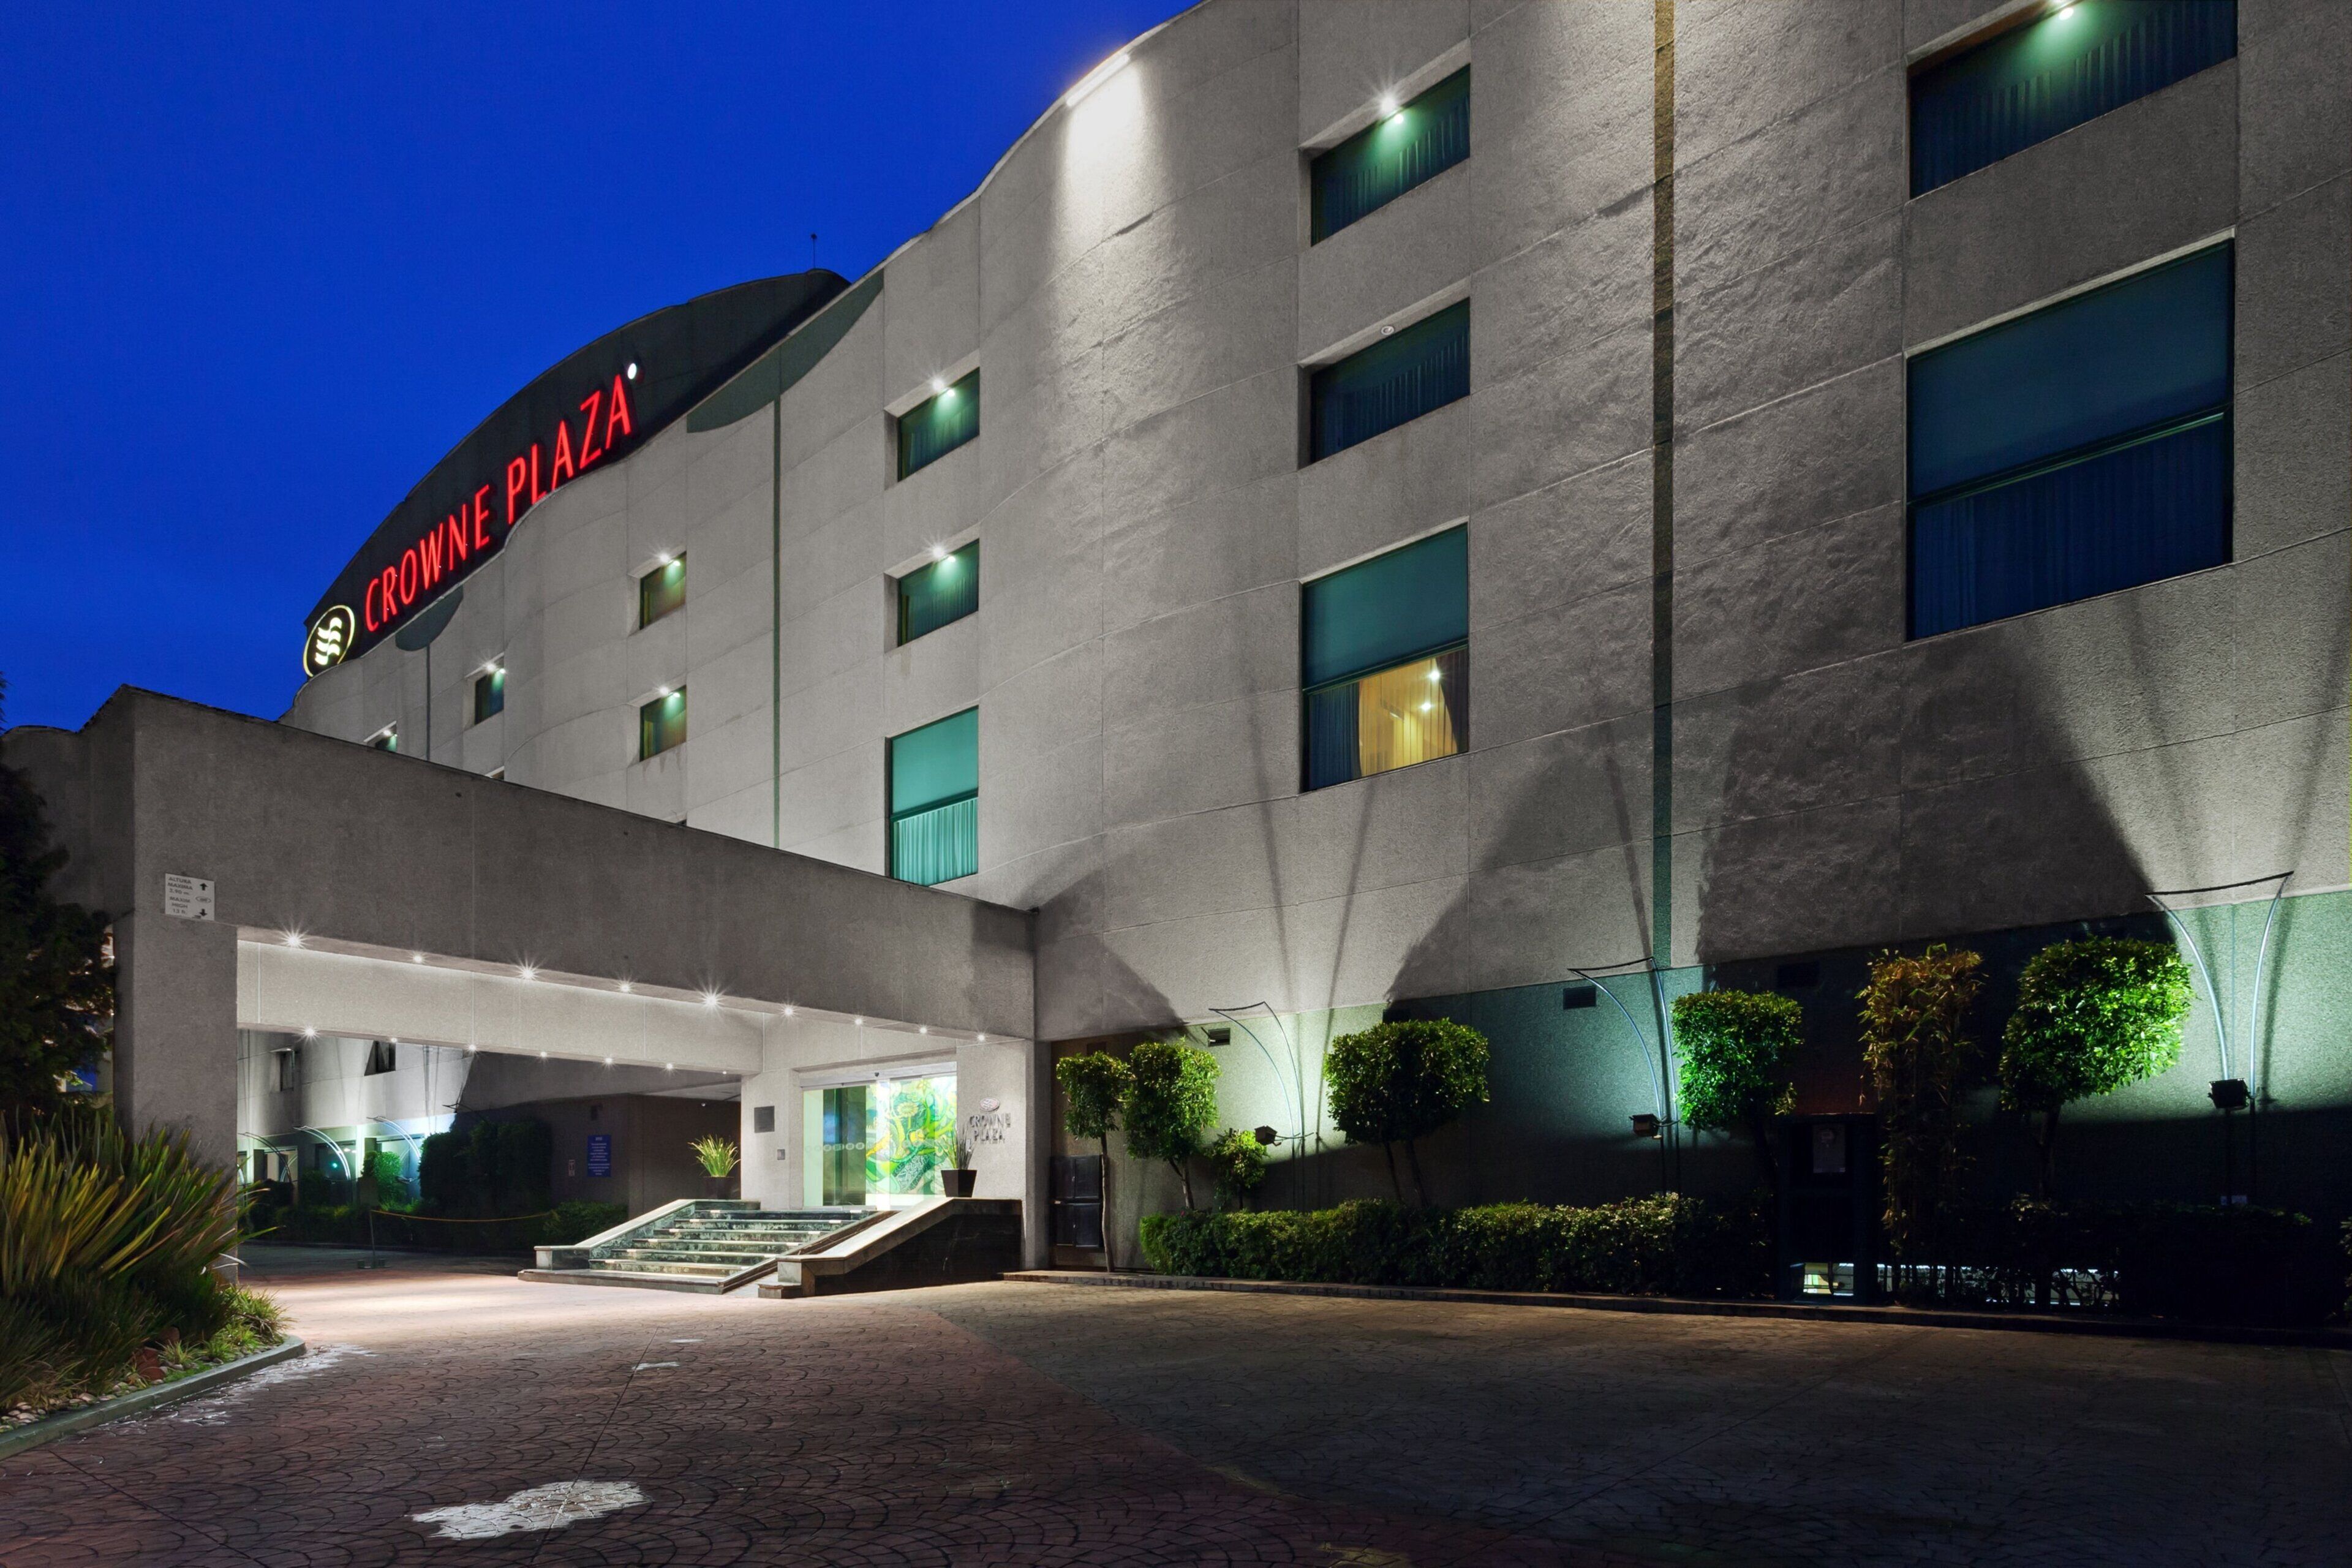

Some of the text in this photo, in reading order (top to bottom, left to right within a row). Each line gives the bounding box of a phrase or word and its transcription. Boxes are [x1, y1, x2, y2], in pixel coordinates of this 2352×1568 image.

[365, 374, 631, 632] CROWNE PLAZA
[970, 1113, 1011, 1128] CROWNE
[973, 1128, 1005, 1143] PLAZA
